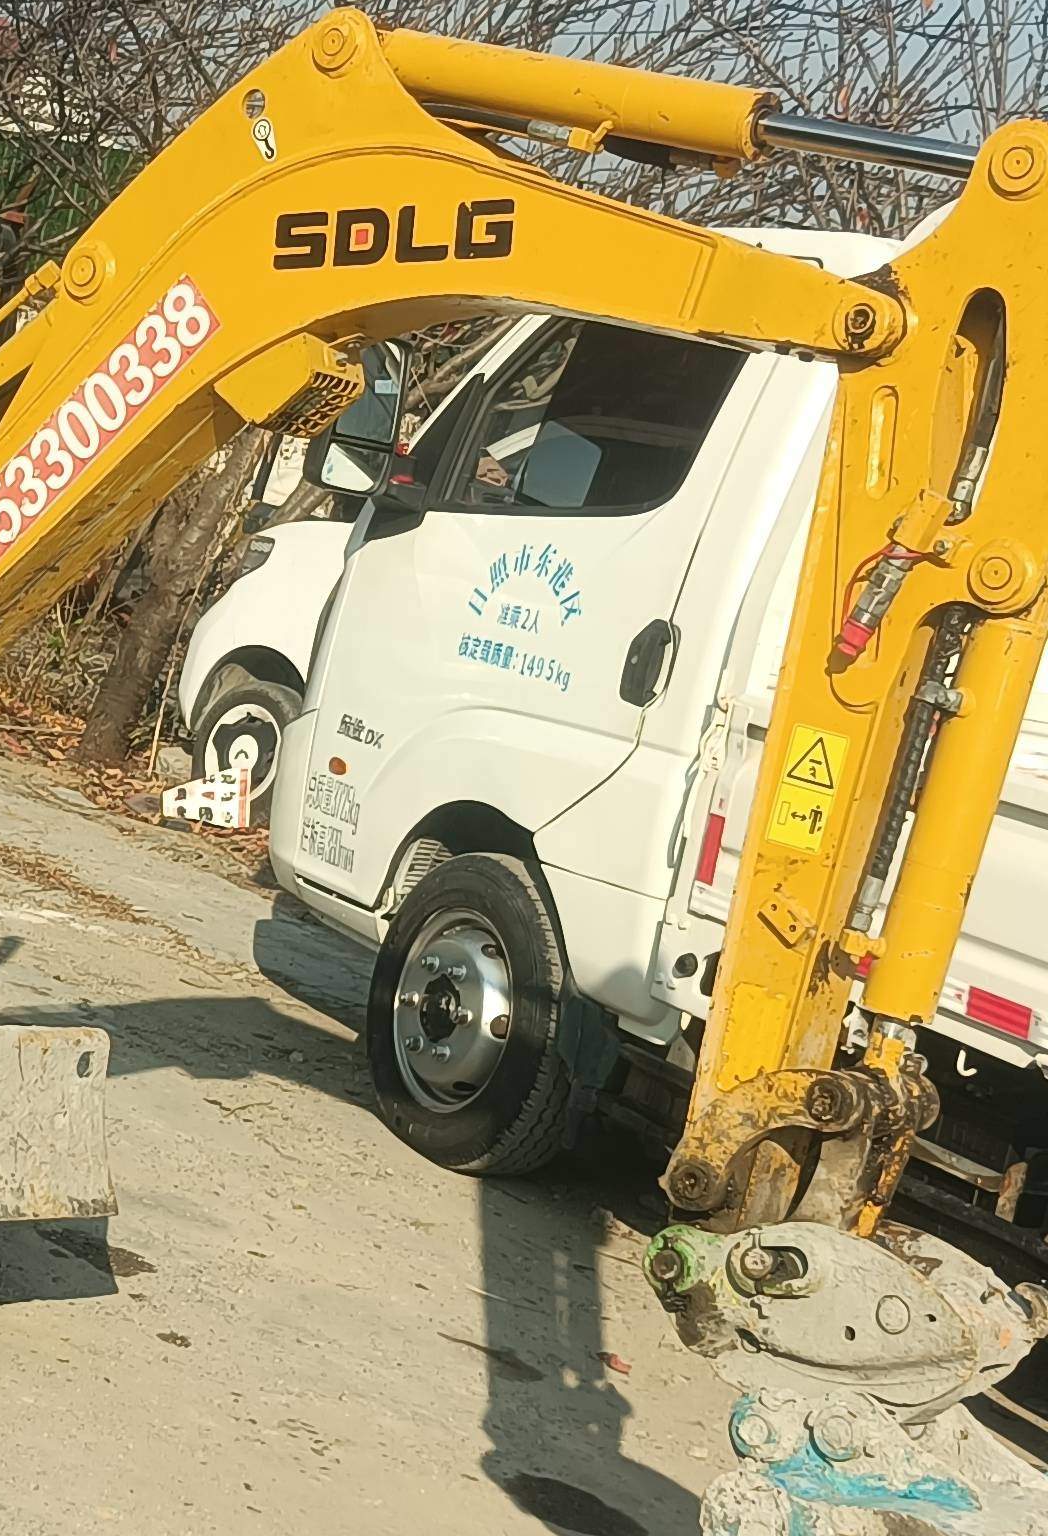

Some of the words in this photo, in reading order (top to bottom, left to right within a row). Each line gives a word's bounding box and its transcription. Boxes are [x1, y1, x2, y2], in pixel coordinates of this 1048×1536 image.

[273, 198, 515, 270] SDLG
[468, 543, 582, 627] 日照市东港区
